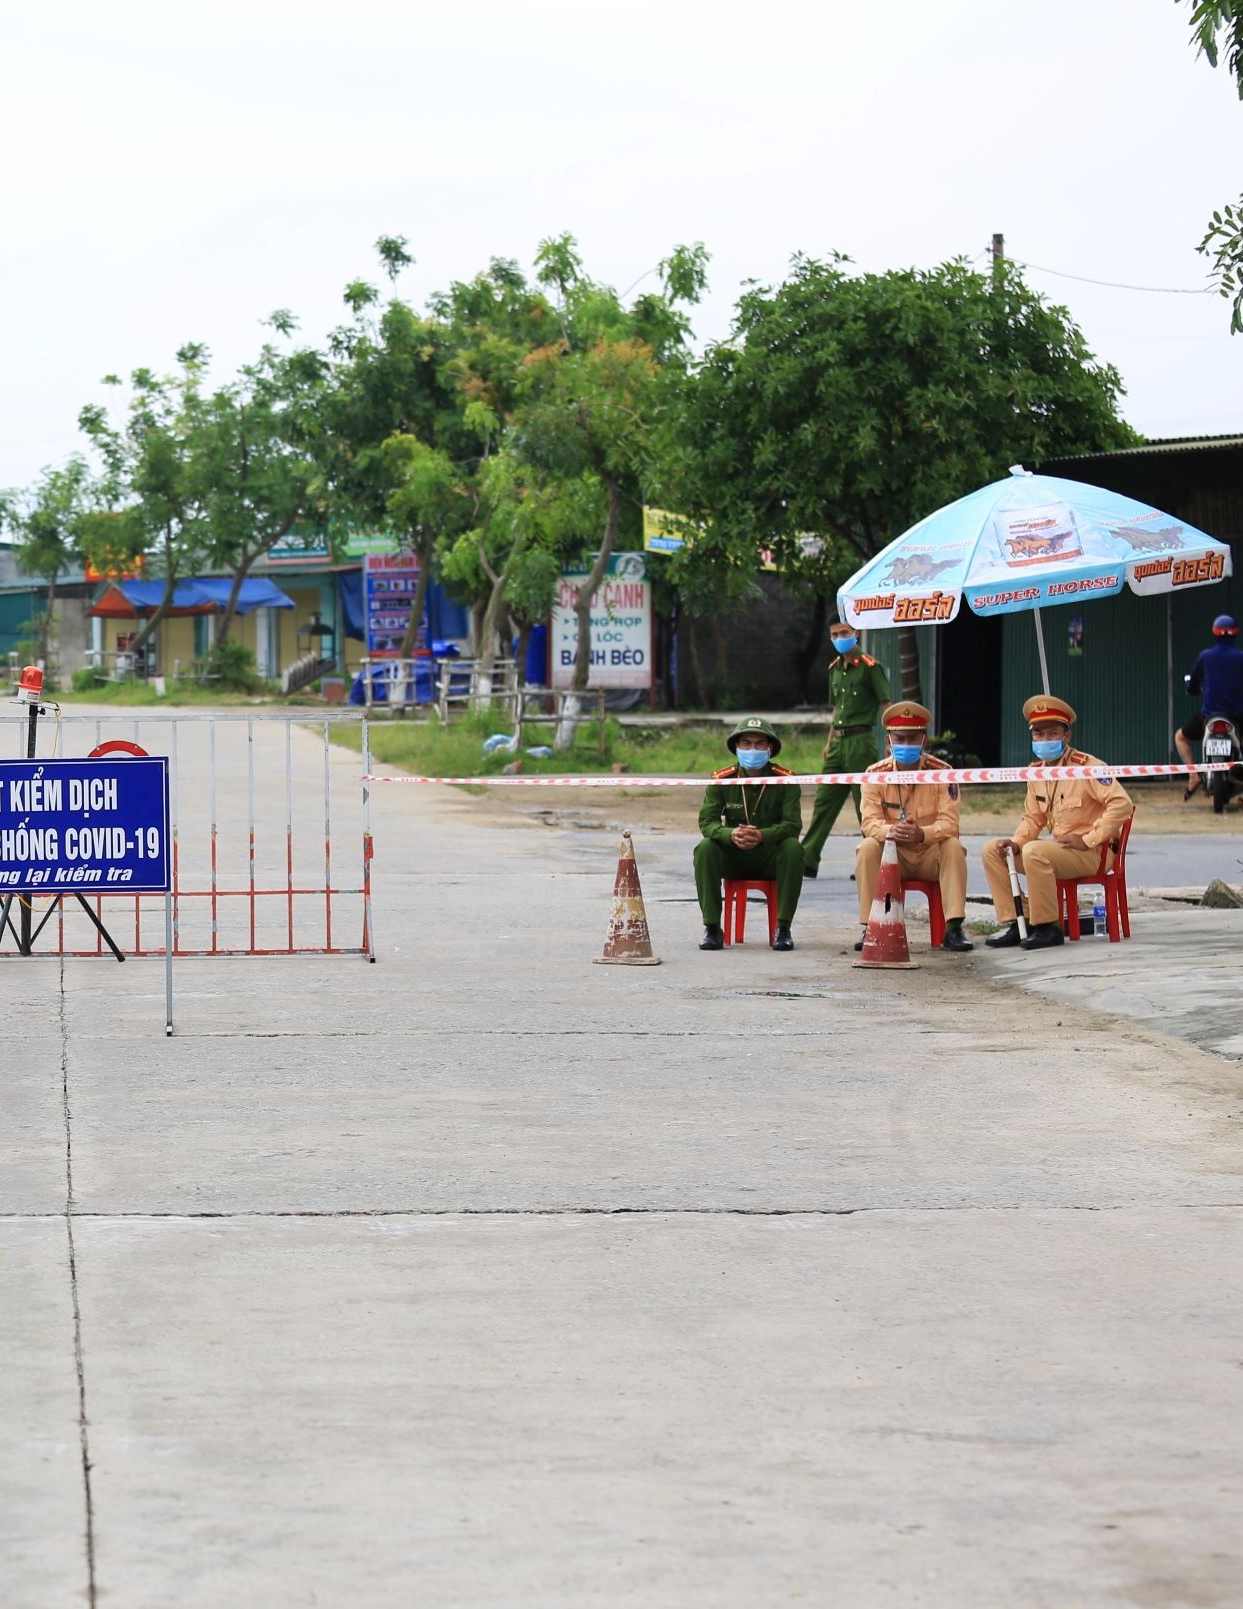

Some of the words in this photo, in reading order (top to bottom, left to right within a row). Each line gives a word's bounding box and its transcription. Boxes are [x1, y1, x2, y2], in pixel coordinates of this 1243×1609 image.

[973, 588, 1040, 609] SUPER
[1048, 575, 1119, 597] HORSE
[573, 617, 610, 627] TNG
[560, 649, 606, 665] BNH
[610, 645, 645, 665] BÈO
[10, 766, 63, 812] KIỂM
[69, 778, 118, 818] DỊCH
[65, 826, 160, 861] COVID-19
[25, 868, 51, 886] lại
[55, 864, 102, 883] kiểm
[108, 867, 133, 882] tra
